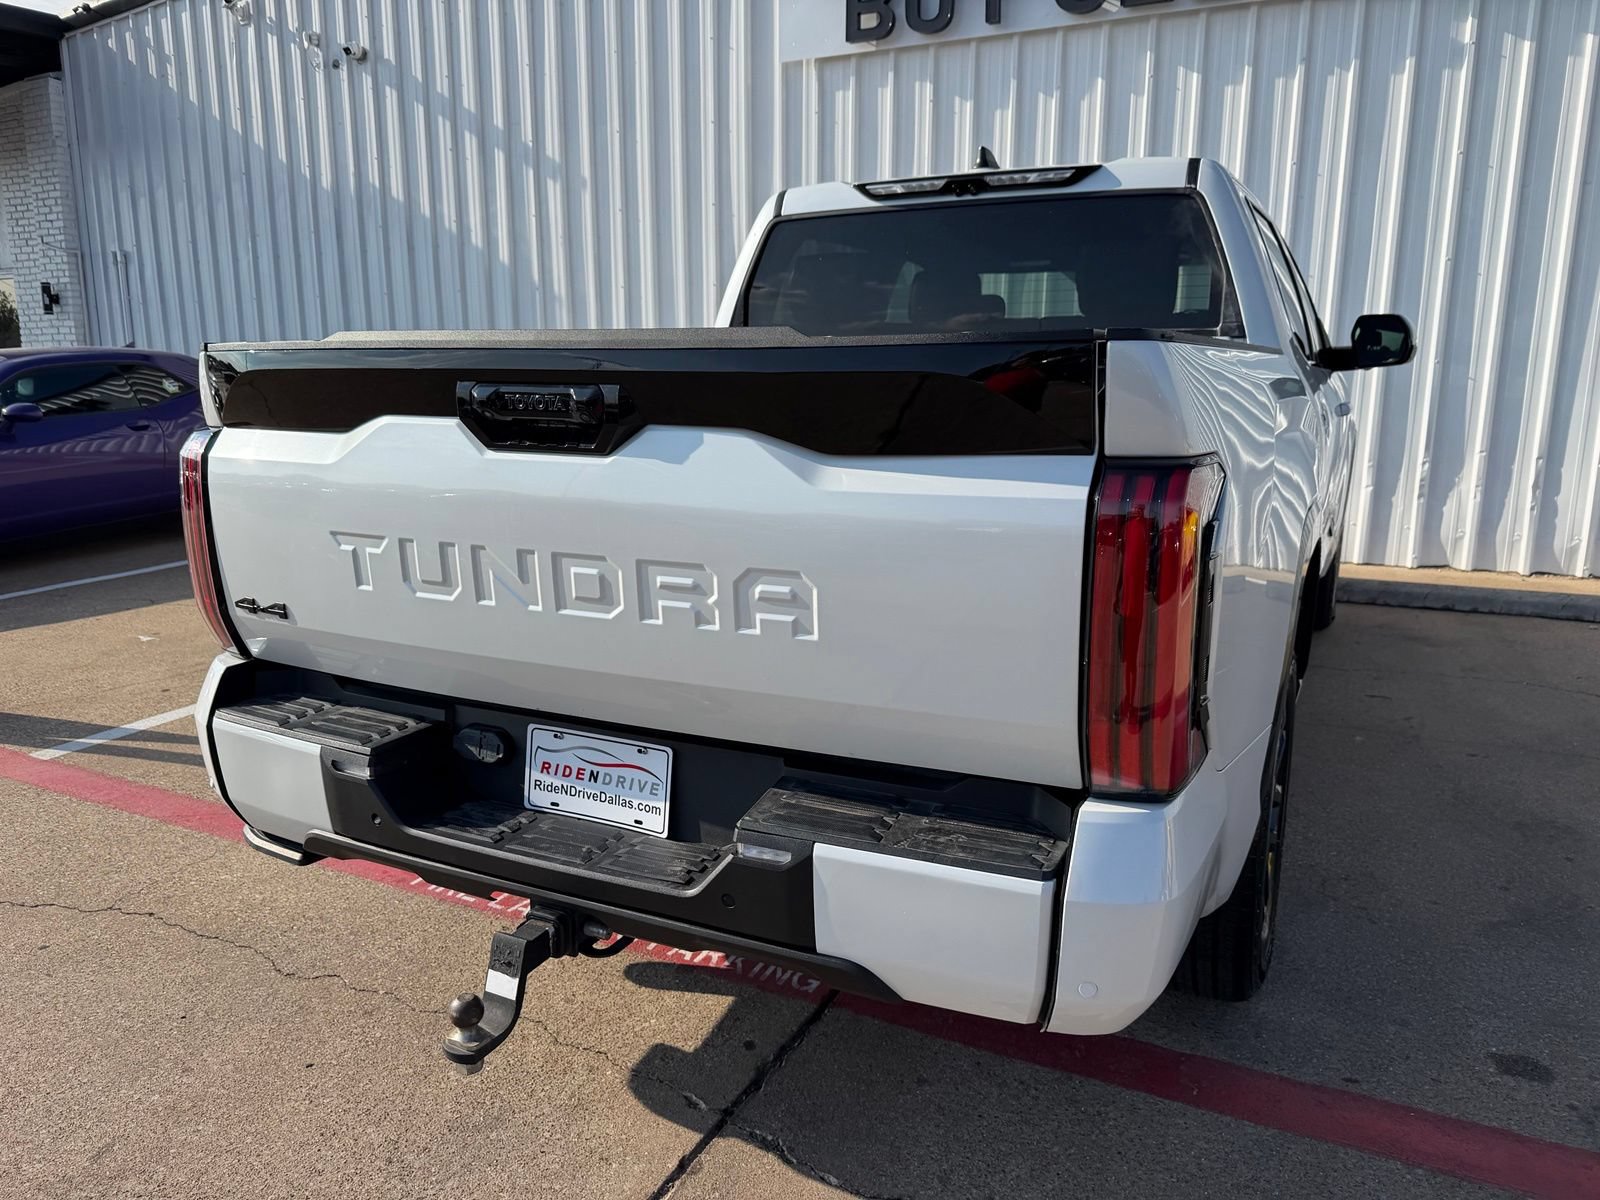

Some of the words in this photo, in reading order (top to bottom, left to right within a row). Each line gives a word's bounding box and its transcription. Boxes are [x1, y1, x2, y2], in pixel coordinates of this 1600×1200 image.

[504, 393, 567, 411] TOYOTA
[329, 530, 819, 642] TUNDRA
[540, 761, 661, 797] RIDENDRIVE
[533, 779, 662, 817] RideNDriveDallas.com
